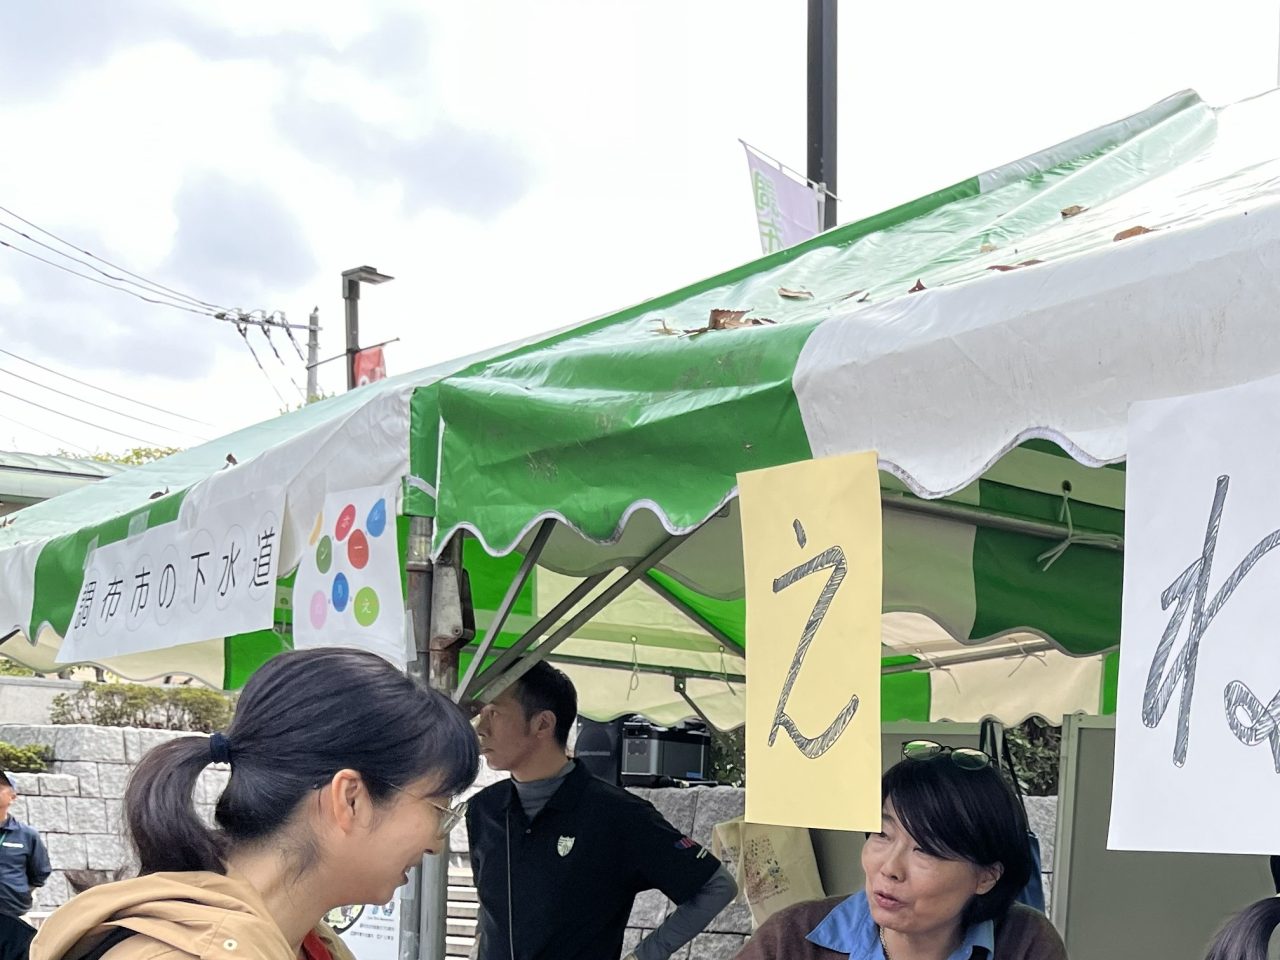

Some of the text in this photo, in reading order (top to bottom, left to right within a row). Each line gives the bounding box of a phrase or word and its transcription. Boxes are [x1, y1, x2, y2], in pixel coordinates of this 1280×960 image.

[73, 528, 276, 630] 調布市の下水道
[767, 518, 860, 760] え
